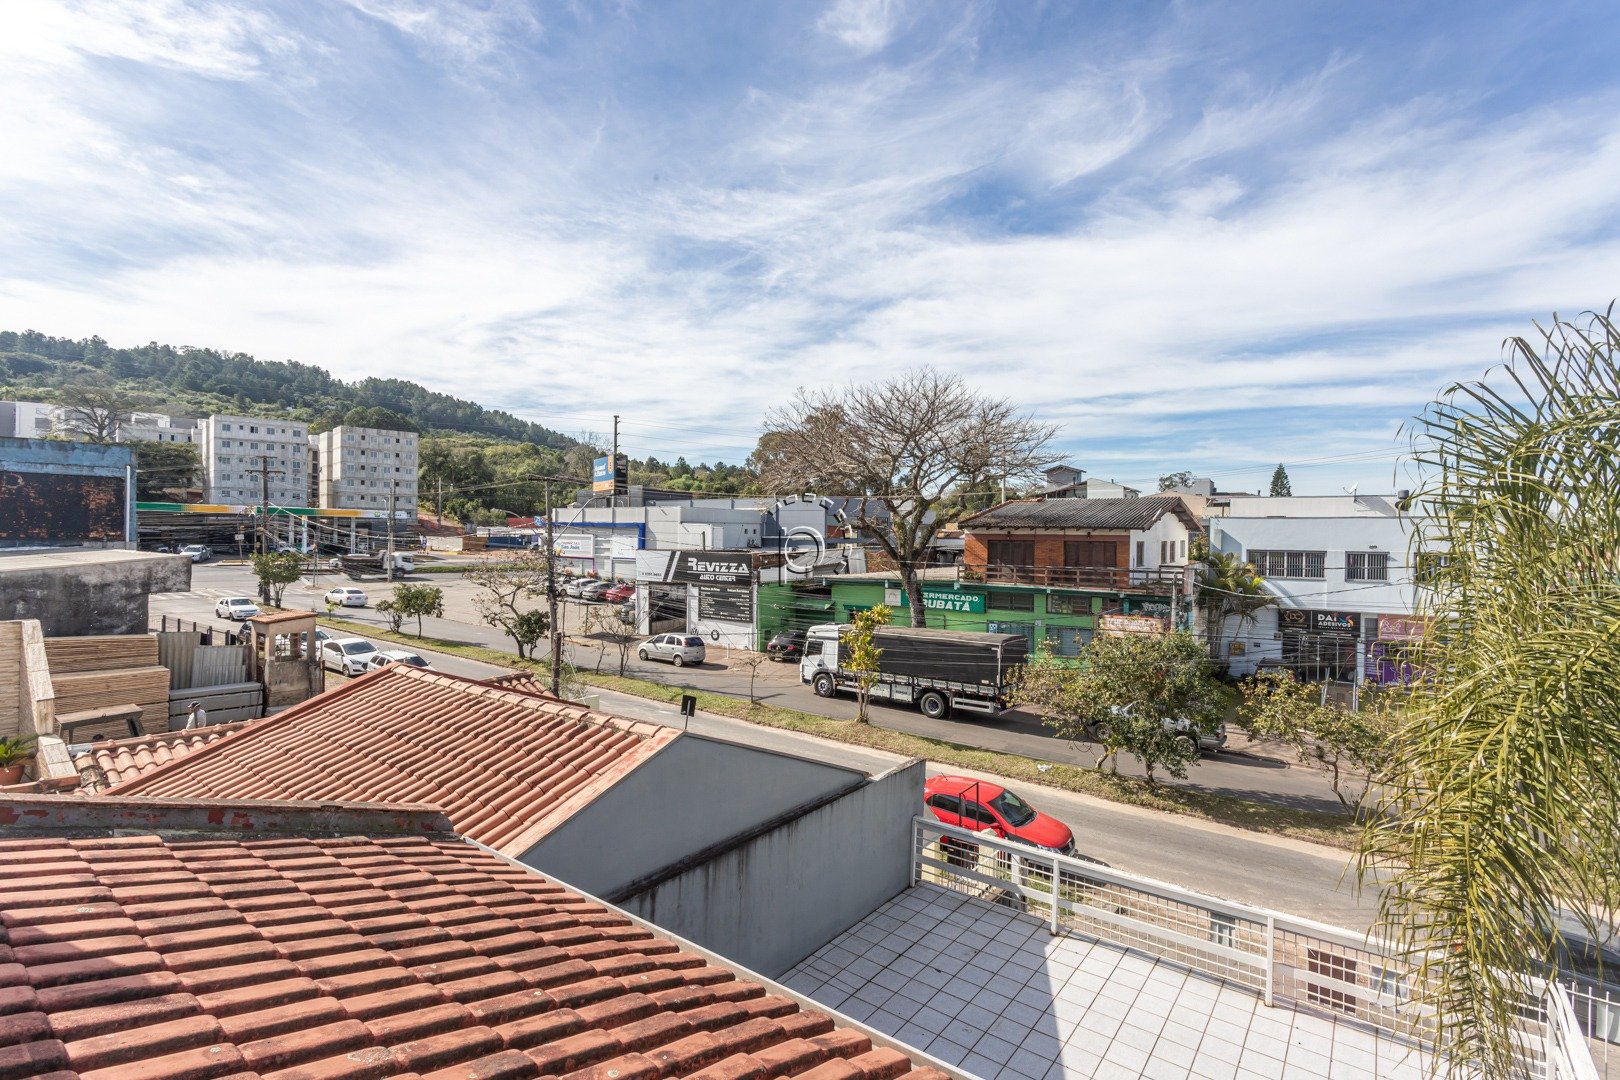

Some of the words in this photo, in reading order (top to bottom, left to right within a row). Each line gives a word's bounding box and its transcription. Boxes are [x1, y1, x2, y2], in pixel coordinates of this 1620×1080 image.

[687, 557, 750, 574] REVIZZA
[715, 574, 736, 582] CENTER
[922, 592, 979, 602] ERMERCADO
